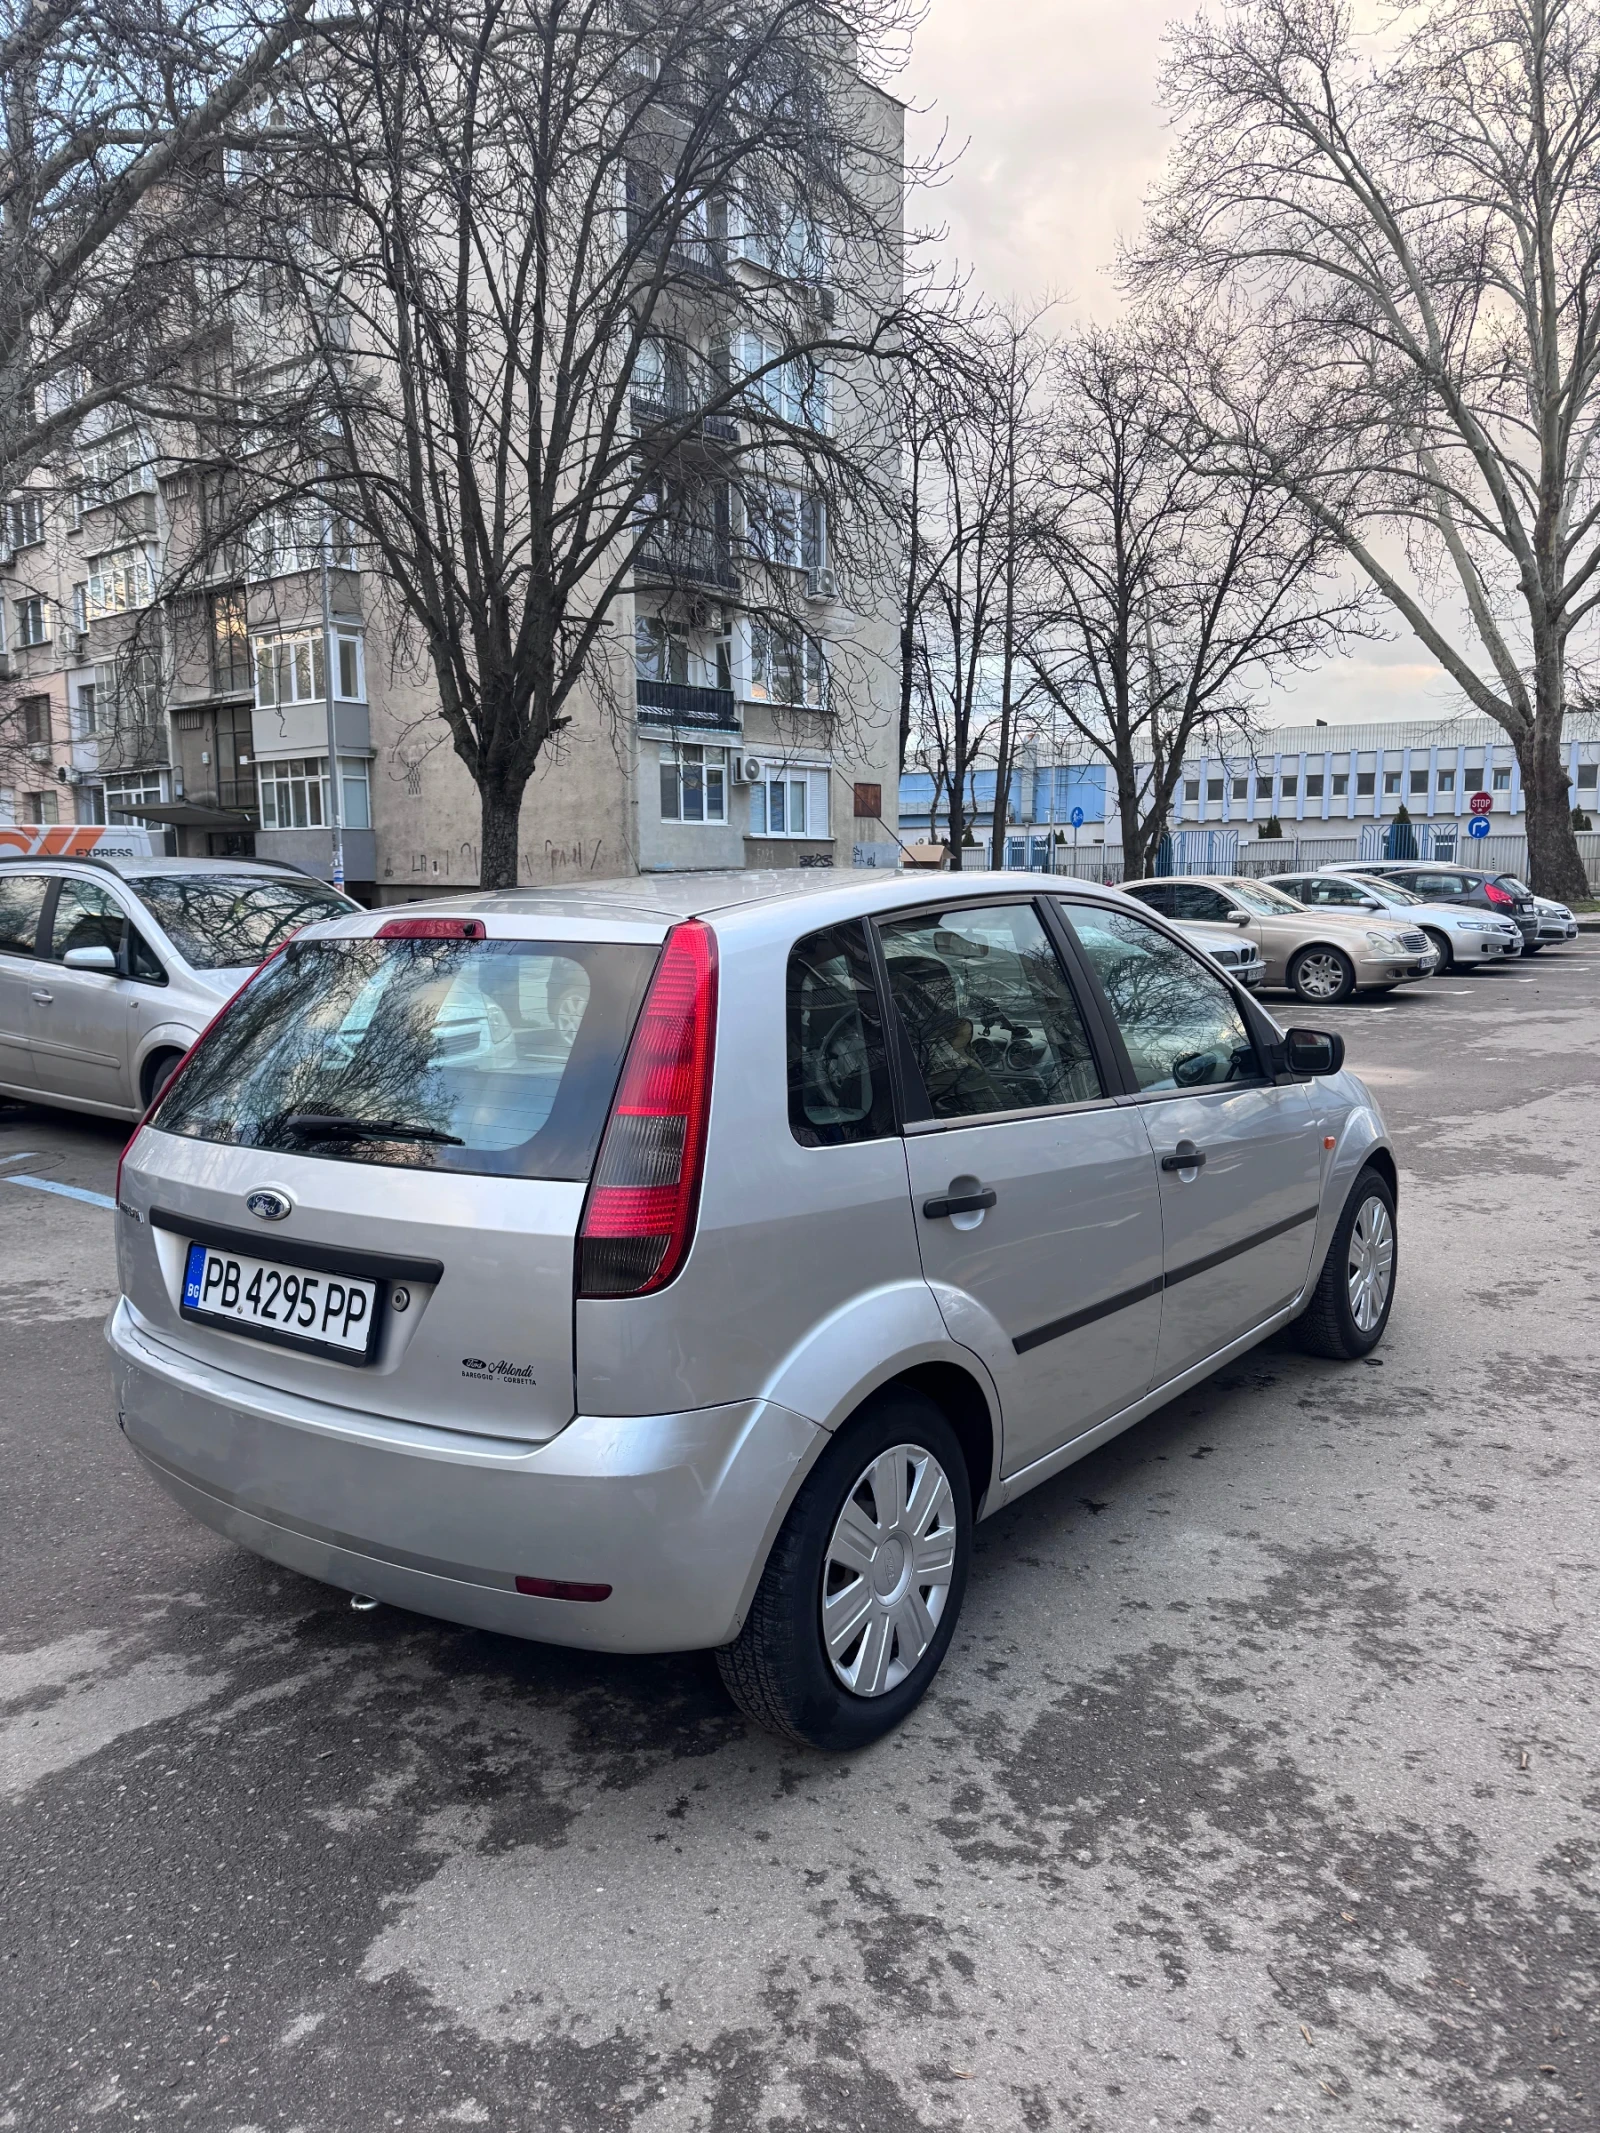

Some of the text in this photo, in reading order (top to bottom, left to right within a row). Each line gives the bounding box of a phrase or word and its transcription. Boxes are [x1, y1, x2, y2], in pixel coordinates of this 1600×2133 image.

[1472, 799, 1490, 808] STOP
[76, 848, 133, 857] EXPRESS
[187, 1283, 200, 1298] BG
[203, 1256, 367, 1337] PB 4295 PP
[465, 1359, 534, 1377] Ford Ablondi
[461, 1371, 493, 1380] BAREGGIO
[503, 1376, 537, 1386] CORBETTA
